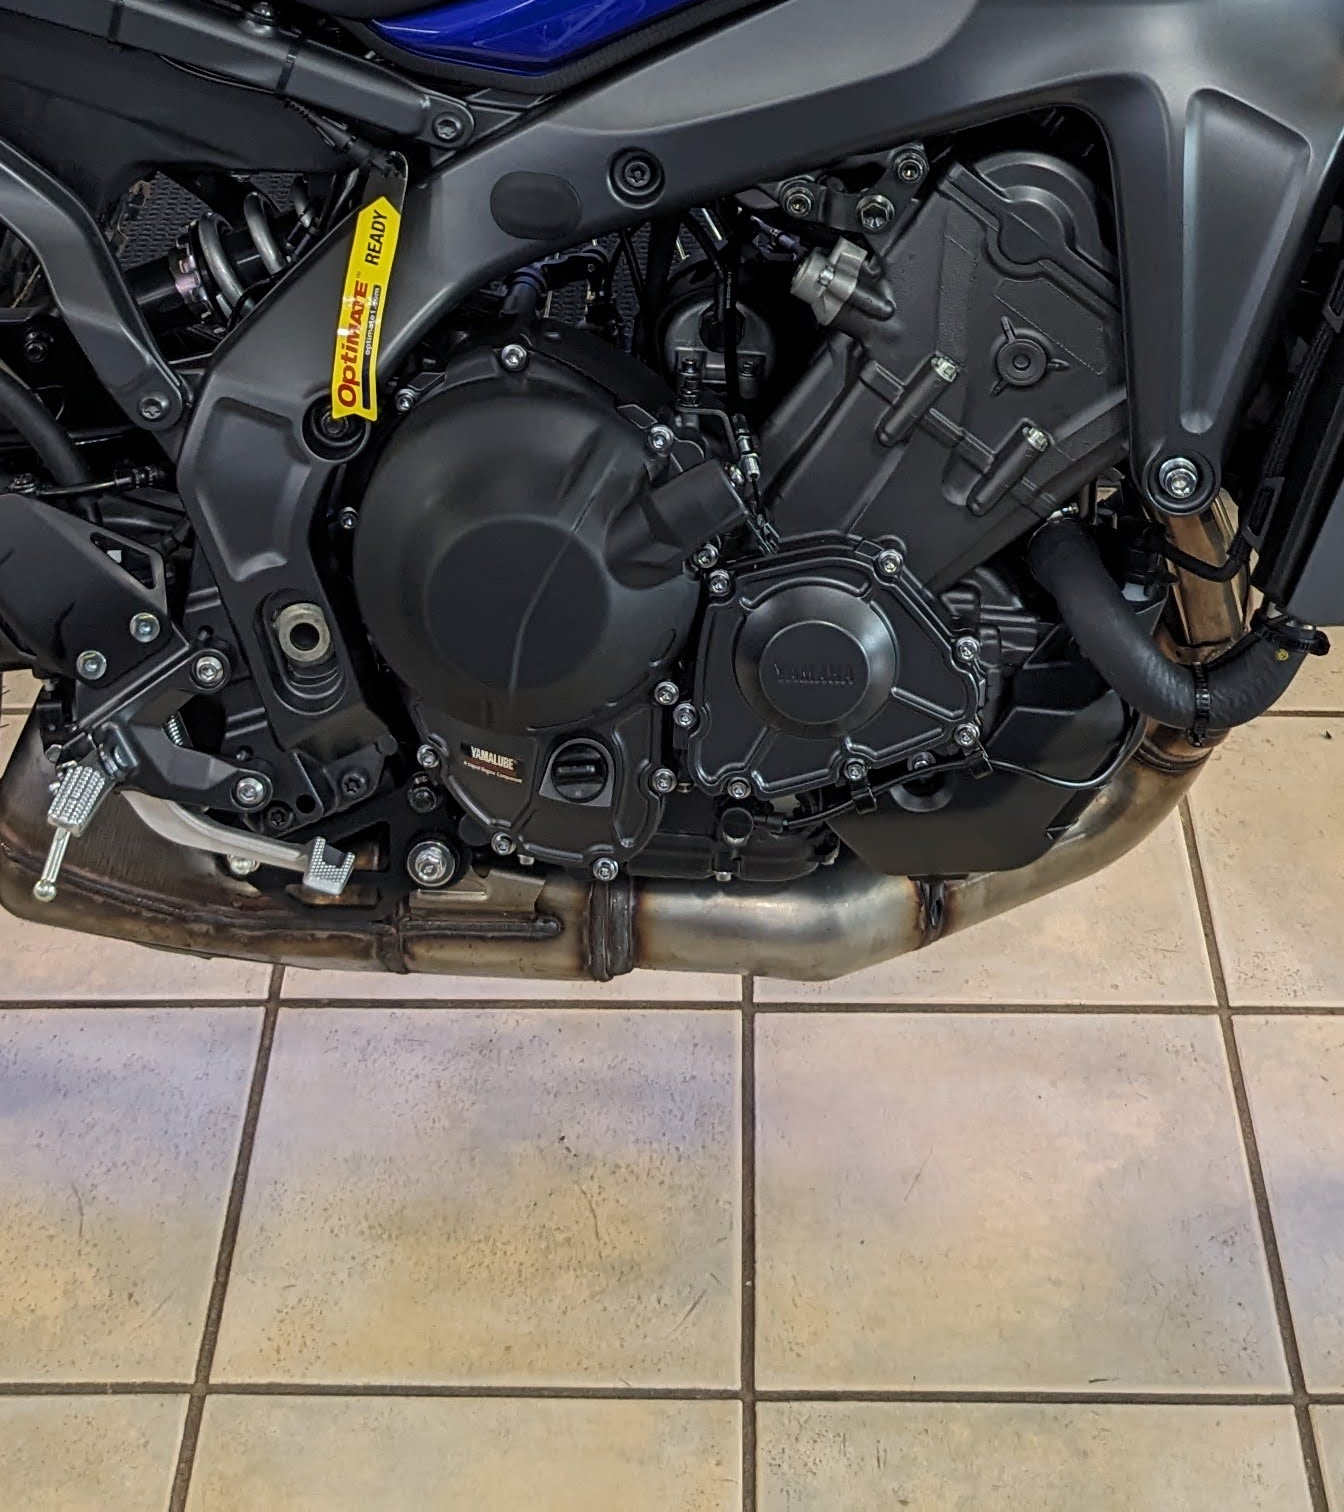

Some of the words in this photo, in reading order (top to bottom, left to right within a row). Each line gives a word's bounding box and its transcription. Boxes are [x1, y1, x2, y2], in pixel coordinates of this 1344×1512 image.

[364, 208, 389, 266] READY
[337, 279, 369, 408] OptiMATE
[470, 745, 515, 771] YAMALUBE
